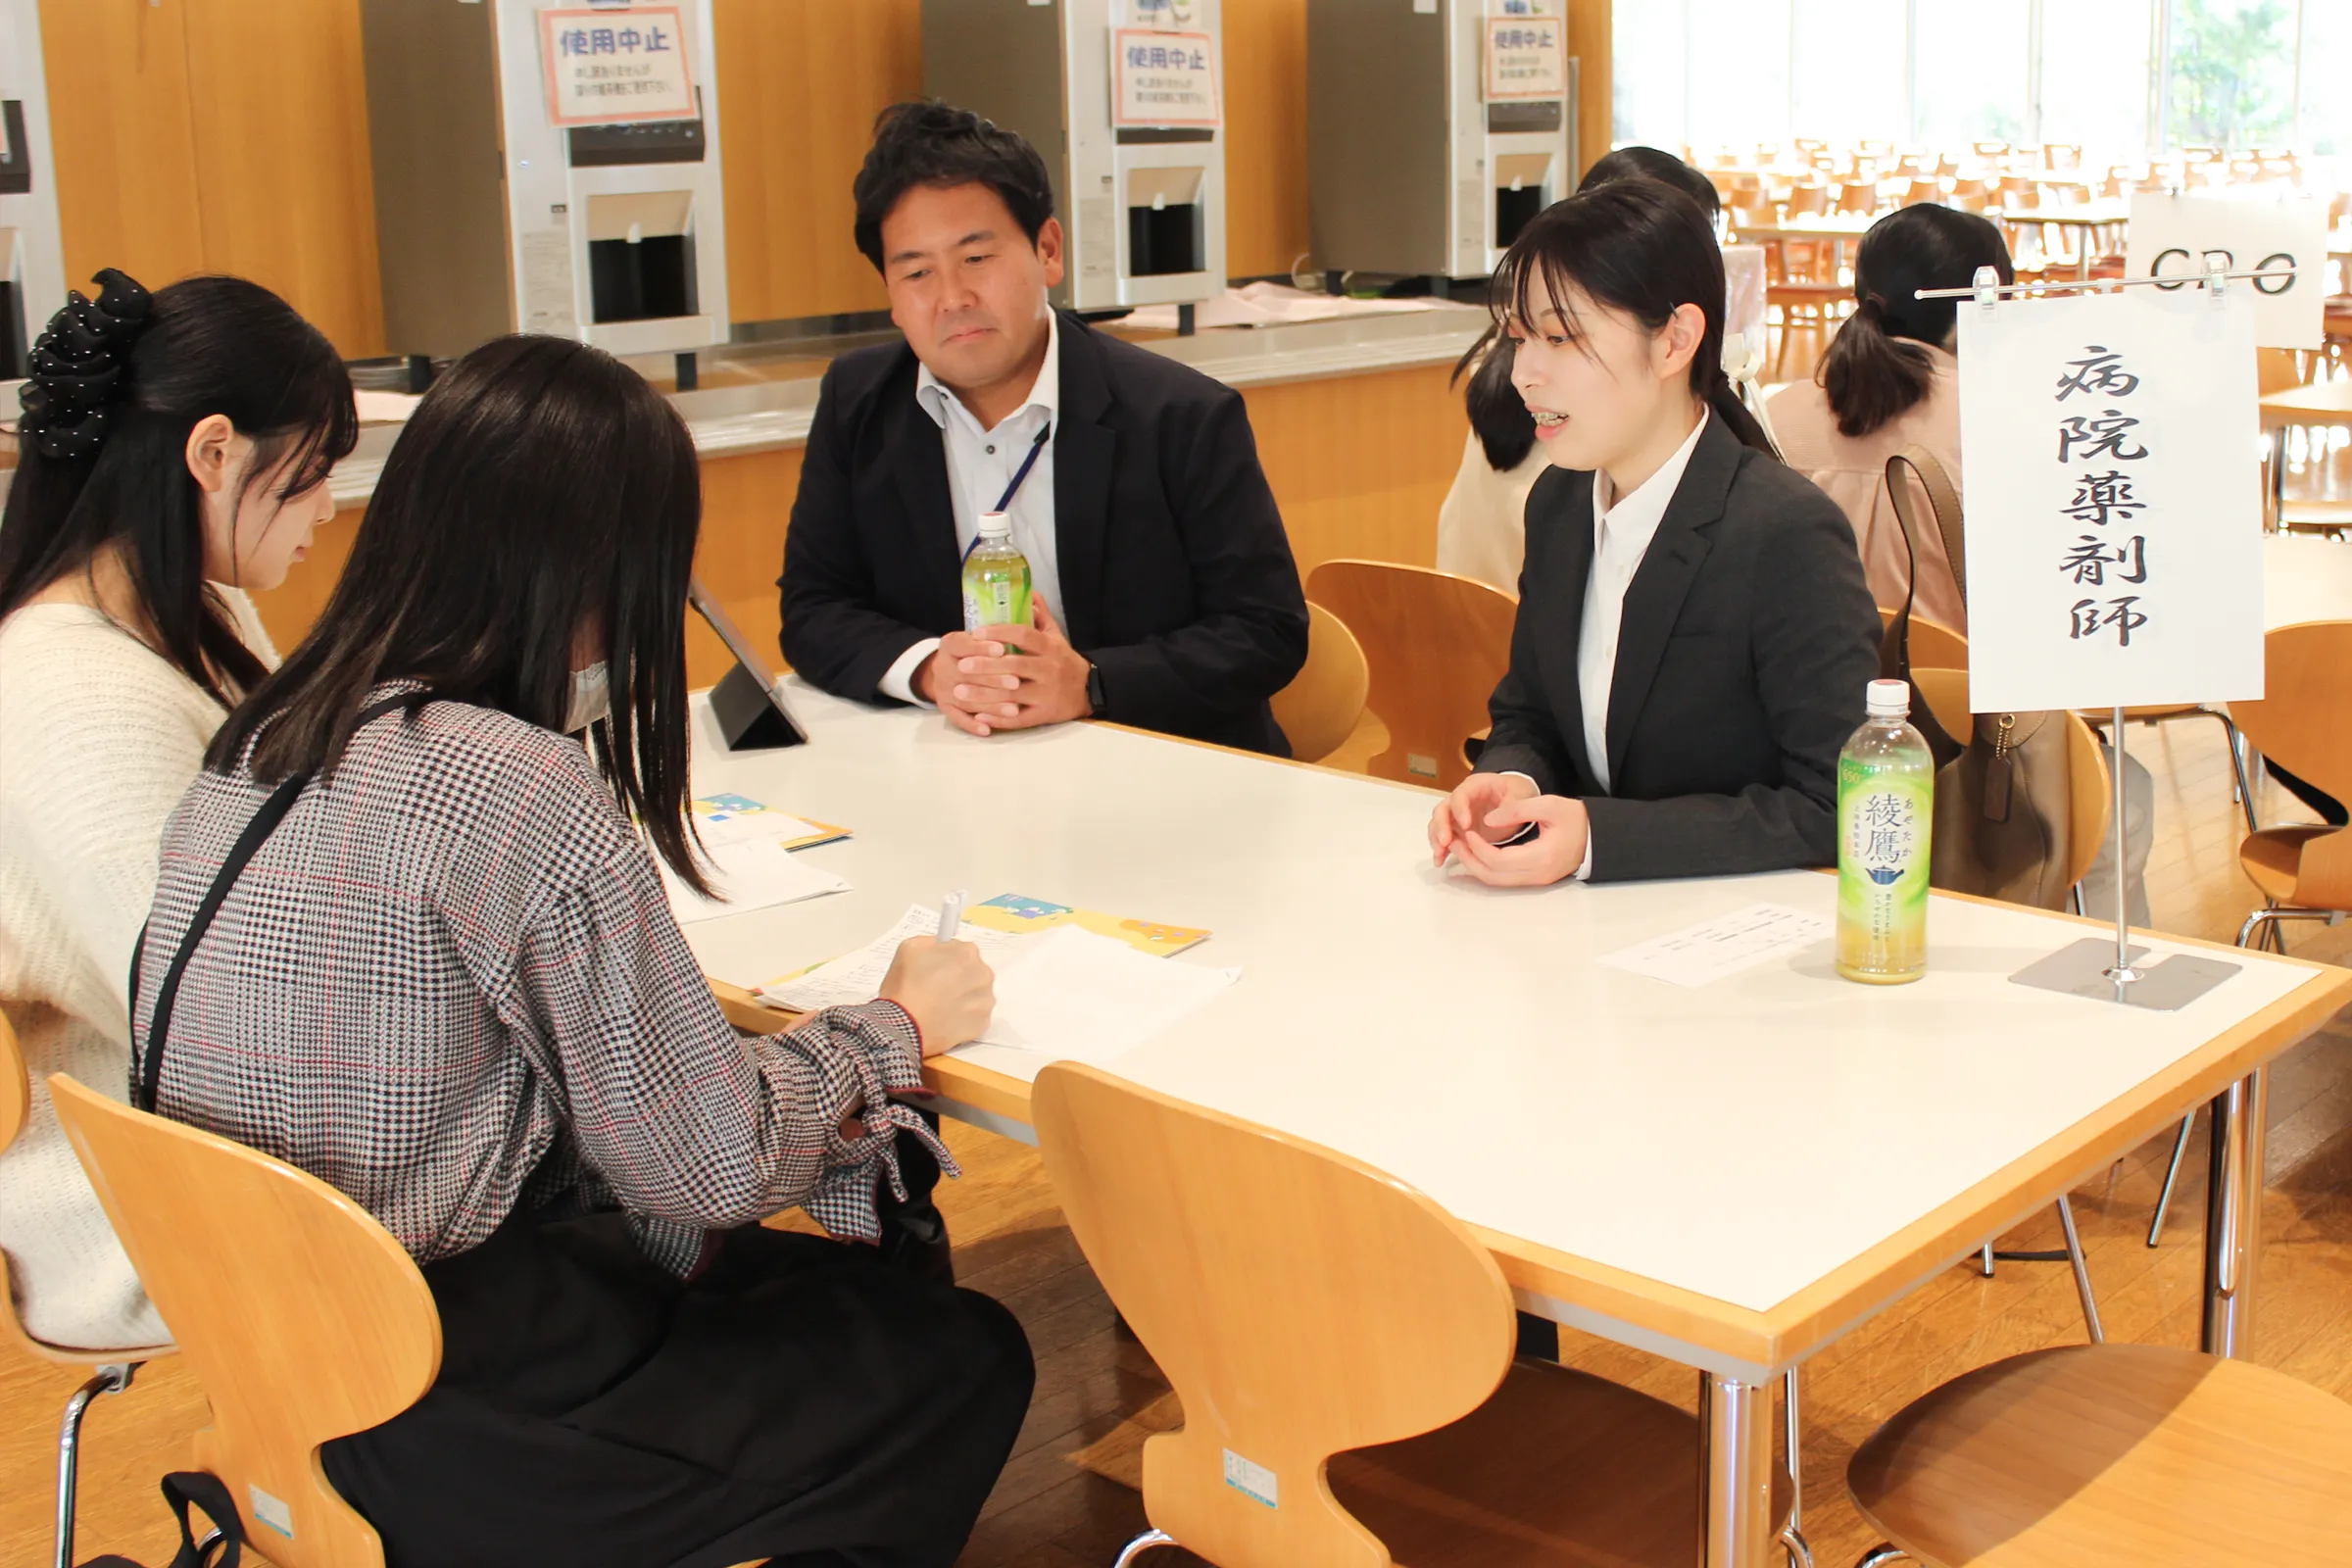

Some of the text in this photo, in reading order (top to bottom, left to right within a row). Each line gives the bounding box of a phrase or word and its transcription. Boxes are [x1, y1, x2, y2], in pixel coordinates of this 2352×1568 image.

[560, 26, 670, 57] 使用中止
[1127, 46, 1205, 70] 使用中止
[1865, 794, 1902, 863] 綾鷹
[1902, 798, 1914, 858] あやたか
